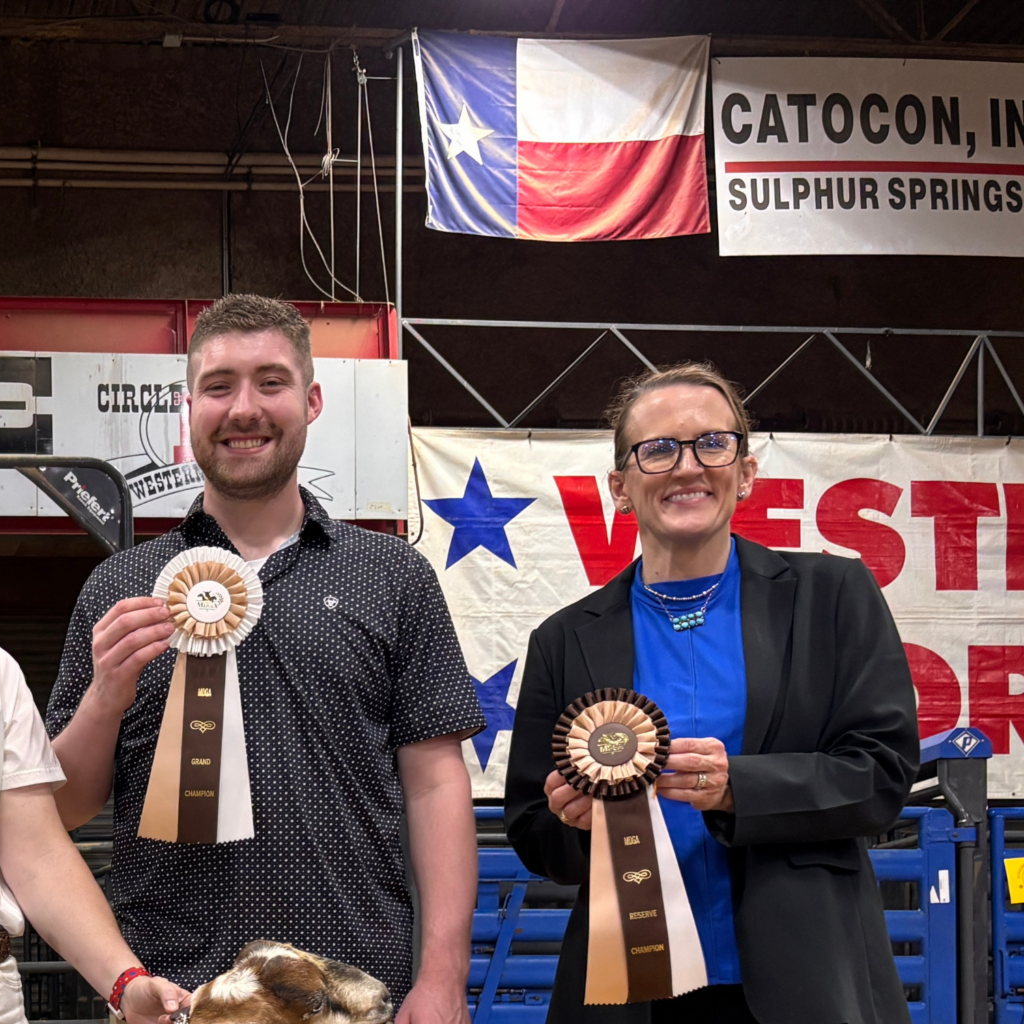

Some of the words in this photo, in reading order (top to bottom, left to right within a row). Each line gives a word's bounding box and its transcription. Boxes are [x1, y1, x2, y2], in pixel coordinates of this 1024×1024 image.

[721, 92, 976, 158] CATOCON,
[728, 177, 880, 211] SULPHUR
[888, 178, 1023, 213] SPRINGS
[97, 383, 183, 413] CIRCLE
[63, 471, 111, 523] Priefert
[191, 757, 211, 765] GRAND
[184, 789, 215, 798] CHAMPION
[629, 909, 658, 920] RESERVE
[631, 943, 664, 955] CHAMPION
